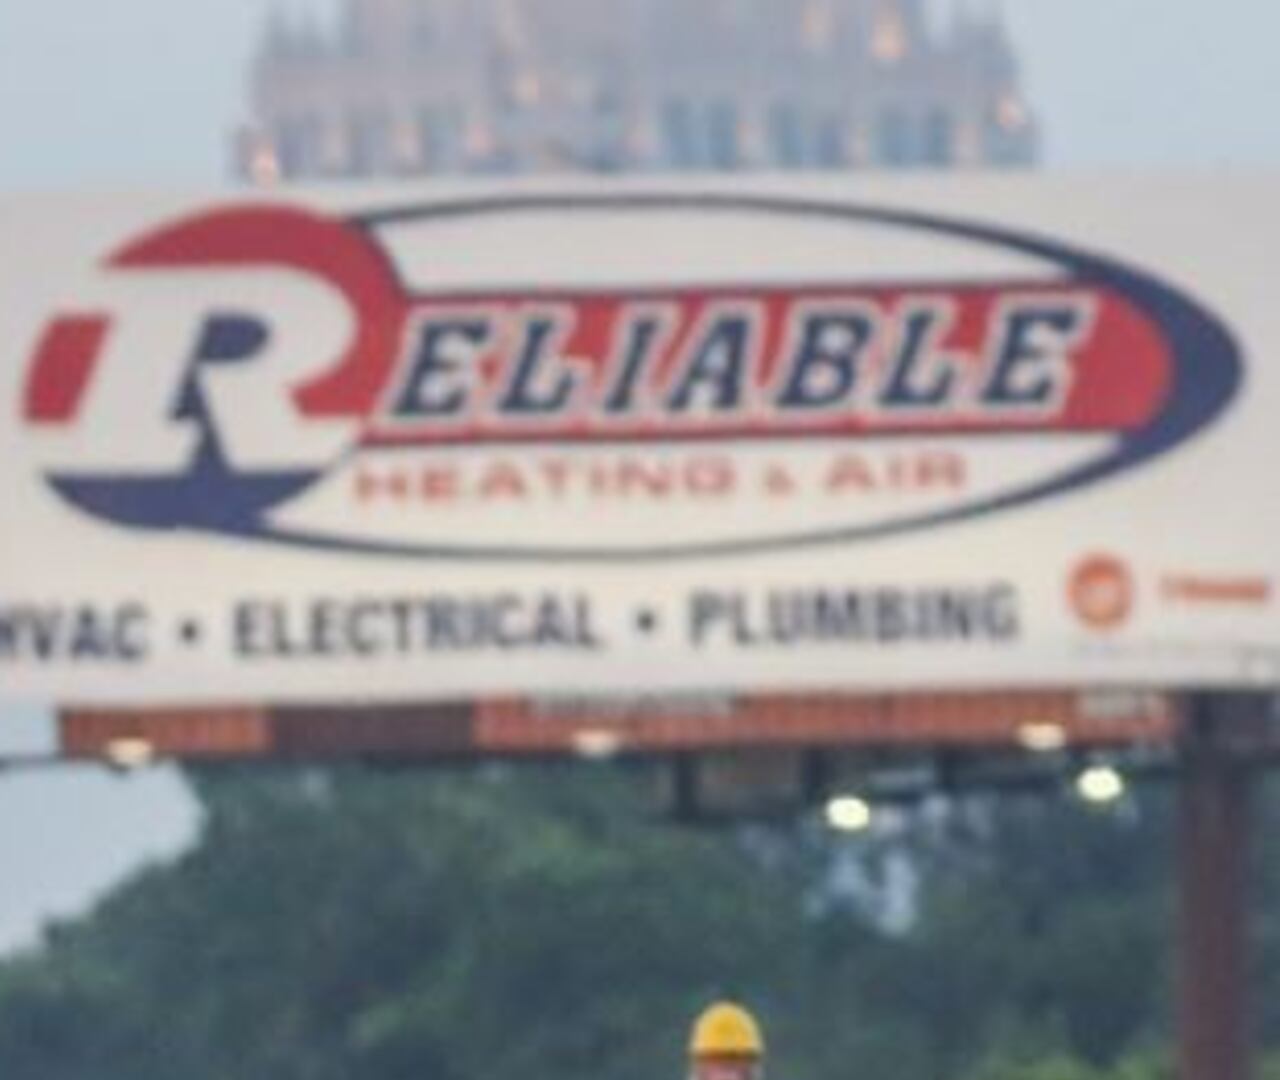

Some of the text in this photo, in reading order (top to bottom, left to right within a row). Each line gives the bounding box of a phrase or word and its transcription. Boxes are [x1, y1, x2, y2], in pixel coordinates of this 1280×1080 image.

[34, 252, 1088, 476] RELIABLE
[354, 453, 736, 504] HEATING
[824, 452, 967, 489] AIR
[233, 592, 602, 657] ELECTRICAL
[688, 583, 1020, 645] PLUMBING
